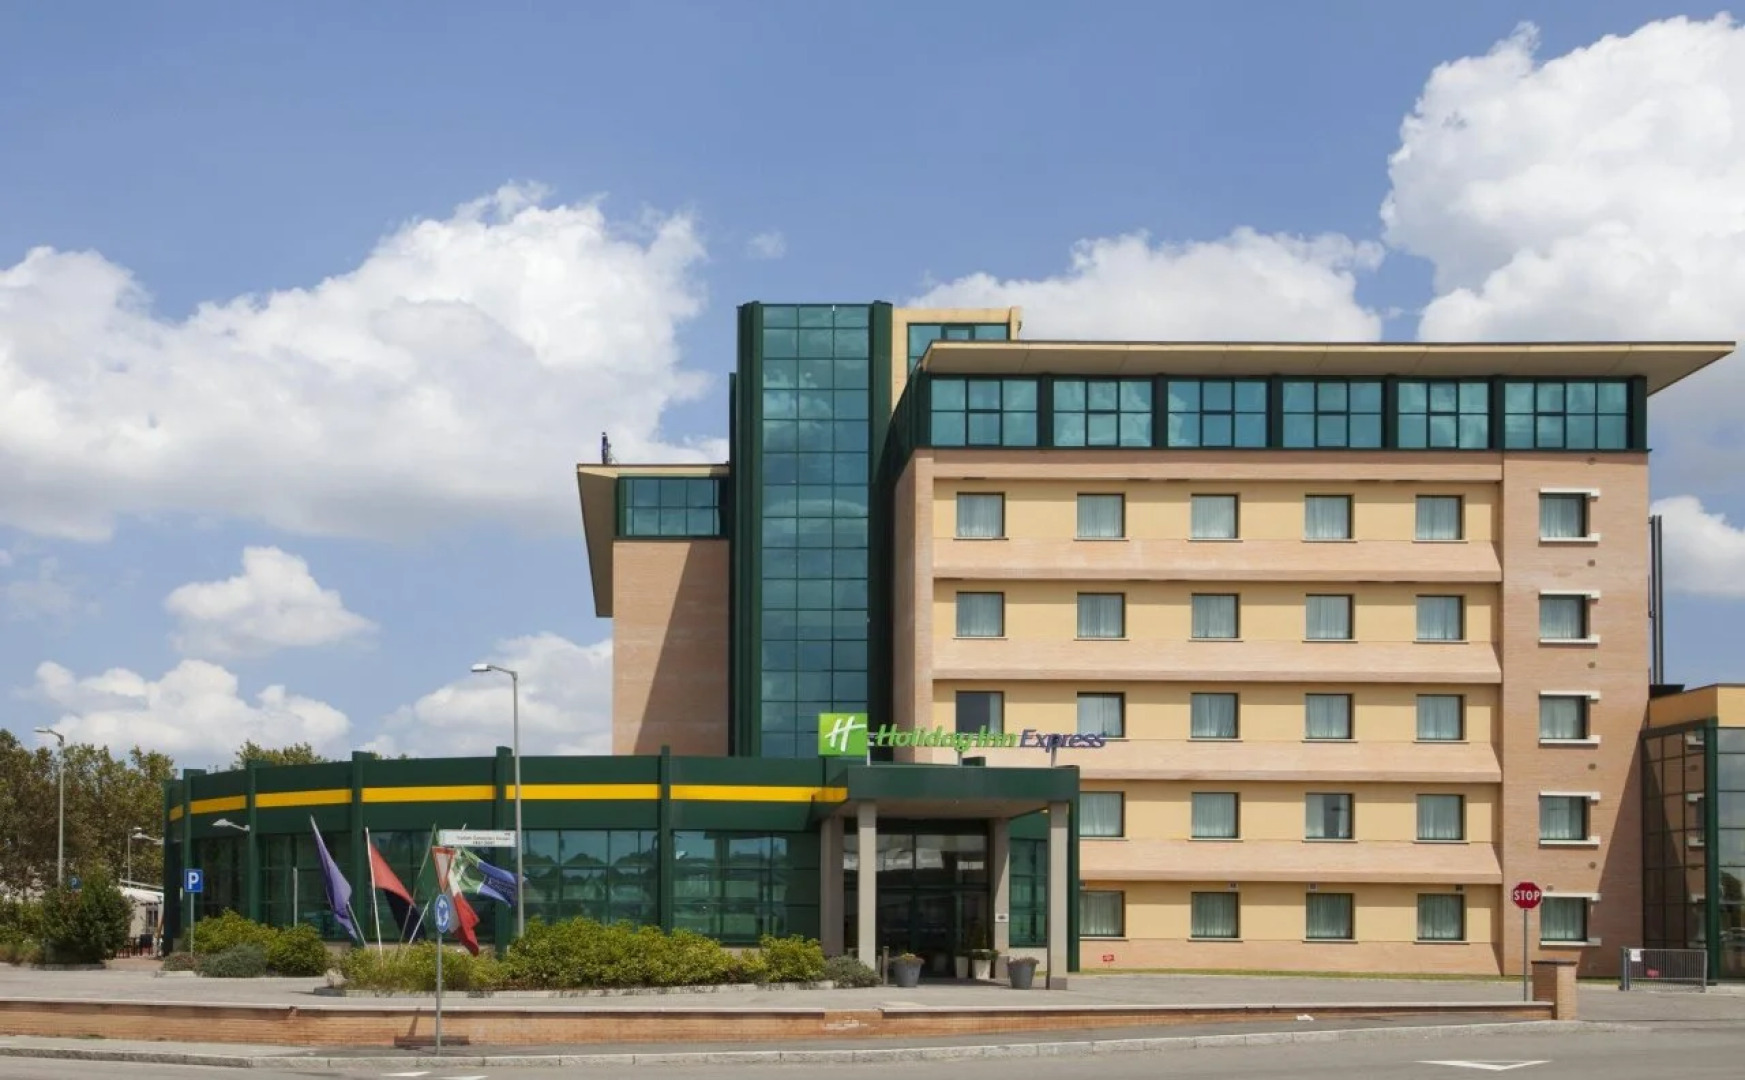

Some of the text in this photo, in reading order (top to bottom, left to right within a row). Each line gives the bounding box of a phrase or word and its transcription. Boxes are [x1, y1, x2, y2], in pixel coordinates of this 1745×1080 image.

[876, 724, 976, 753] Holiday
[977, 725, 1017, 748] Inn
[1020, 729, 1106, 753] Express
[188, 872, 200, 890] P
[1514, 890, 1540, 901] STOP
